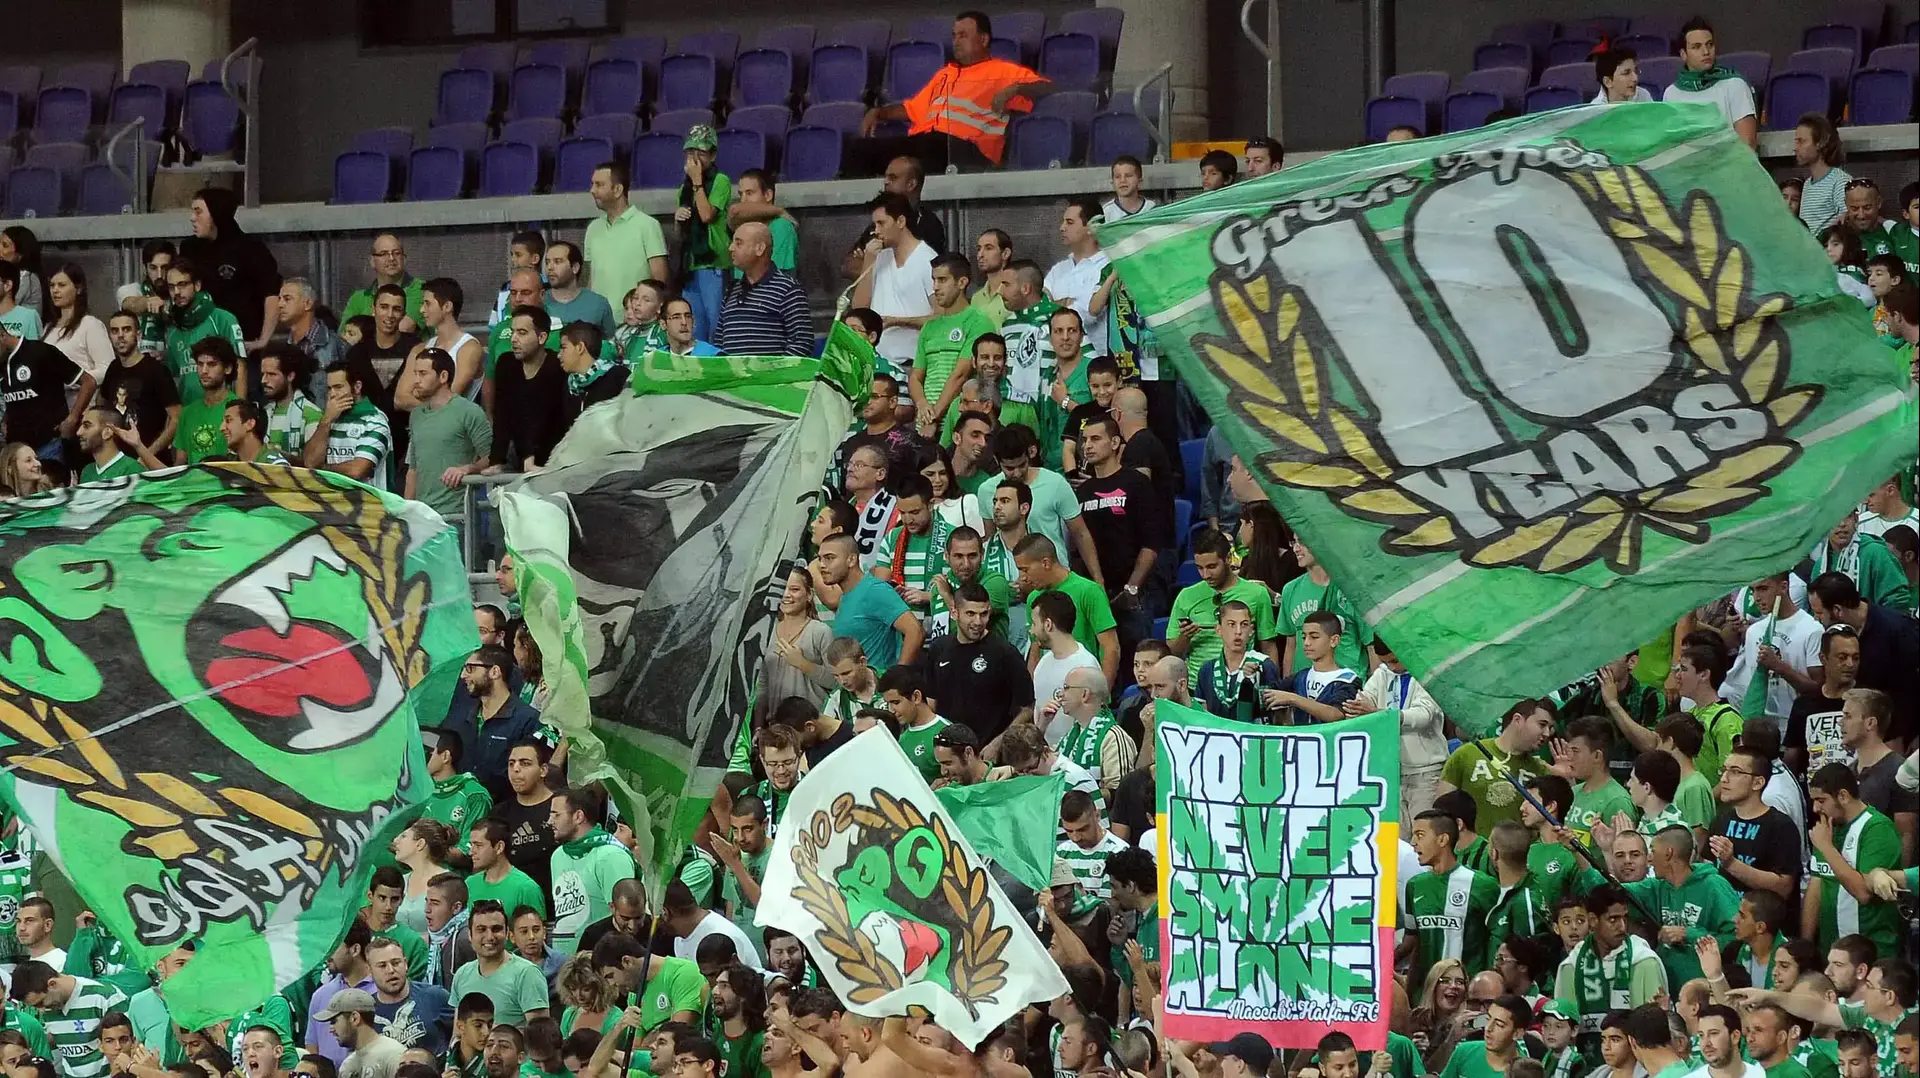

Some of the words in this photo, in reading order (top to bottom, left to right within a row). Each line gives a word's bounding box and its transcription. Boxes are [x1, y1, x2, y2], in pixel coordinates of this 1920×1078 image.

[1212, 174, 1420, 279] Green
[1270, 166, 1673, 467] 10
[4, 389, 39, 402] ONDA
[326, 447, 355, 456] ONDA
[1396, 384, 1767, 539] YEARS
[1162, 727, 1383, 807] YOU'LL
[1169, 797, 1379, 878] NEVER
[1169, 869, 1376, 944] SMOKE
[1166, 936, 1378, 1011] ALONE
[60, 1044, 94, 1056] ONDA
[1227, 999, 1294, 1021] Maccabi
[1297, 1000, 1344, 1026] Haifa
